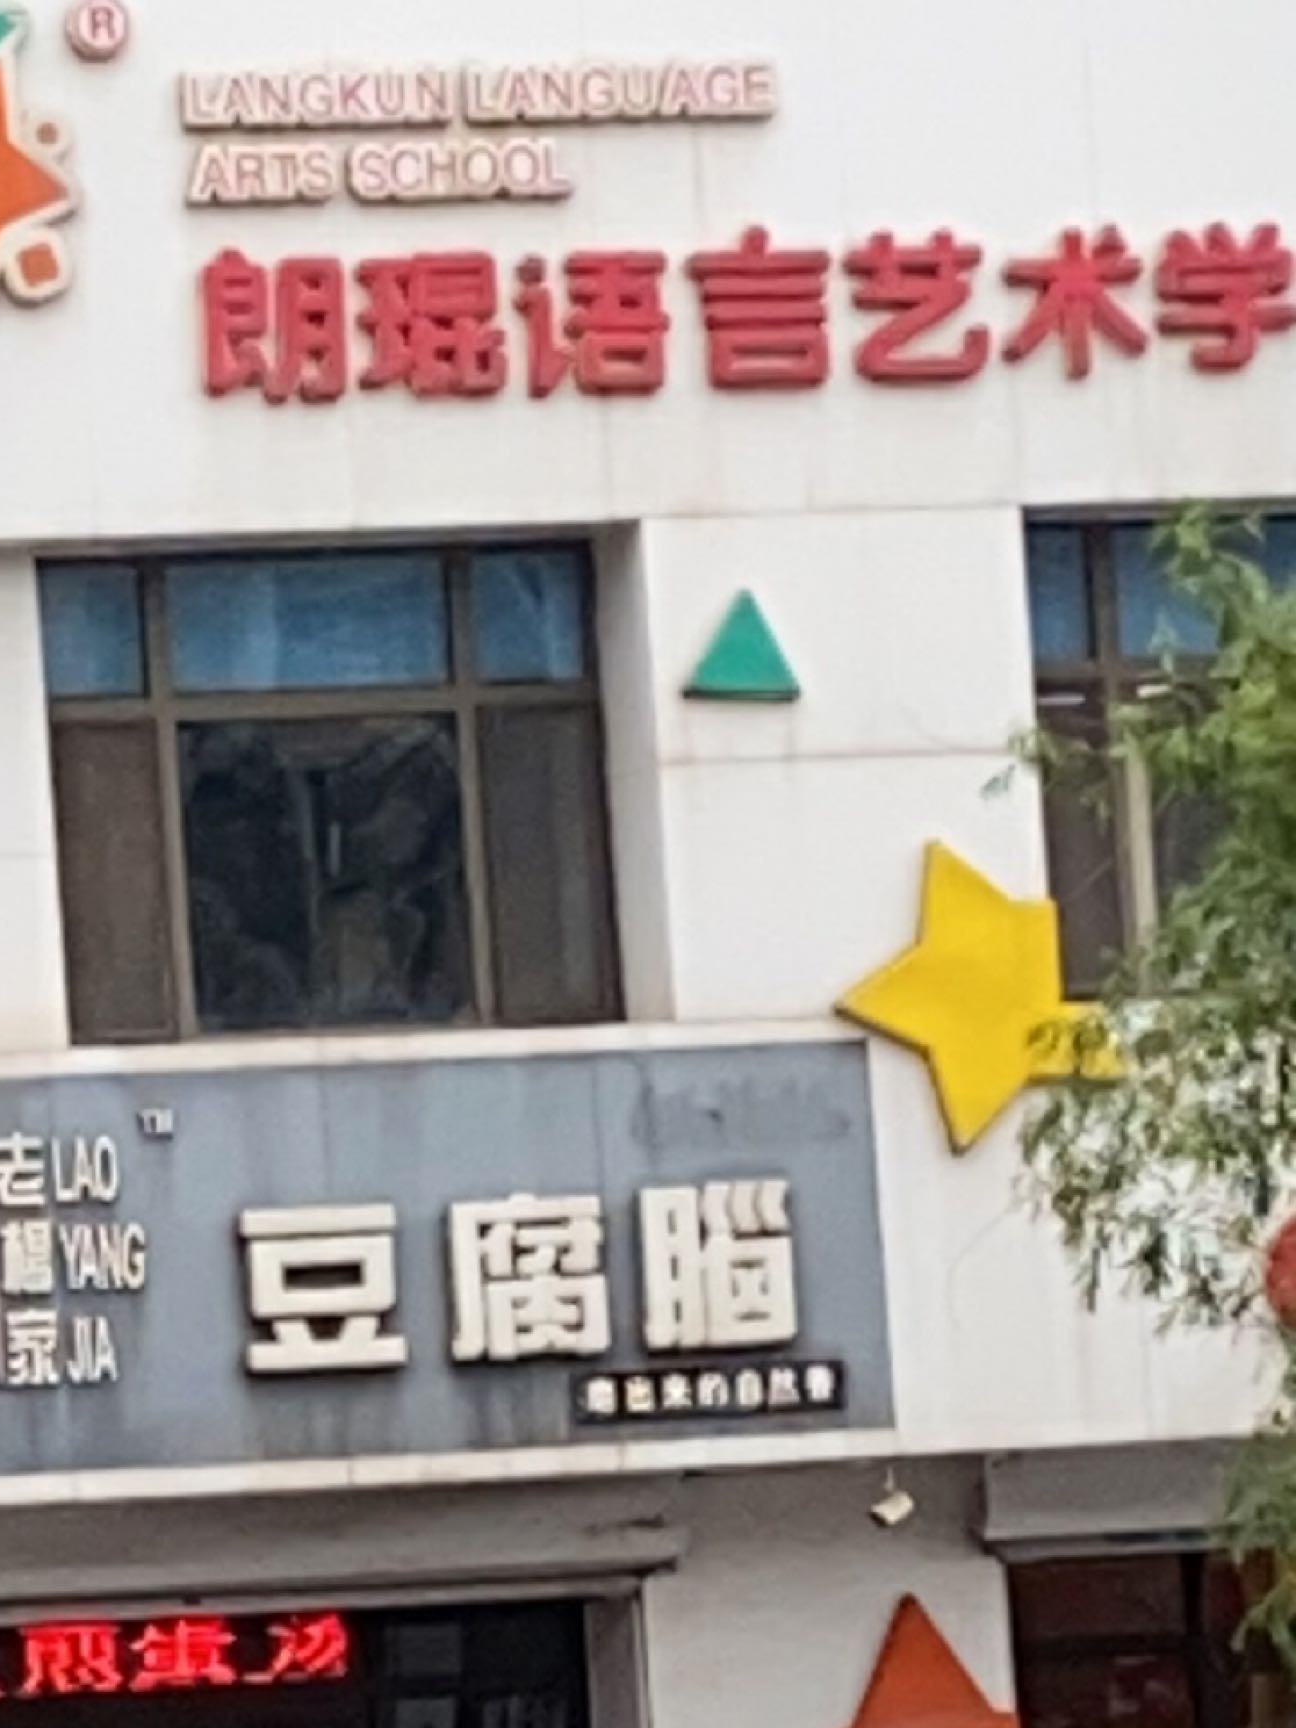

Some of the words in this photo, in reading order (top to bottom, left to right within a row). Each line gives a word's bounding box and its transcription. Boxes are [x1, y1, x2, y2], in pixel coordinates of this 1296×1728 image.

[179, 72, 455, 128] LANGKUN
[464, 63, 776, 122] LANGUAGE
[188, 142, 333, 204] ARTS
[347, 138, 572, 200] SCHOOL
[51, 1135, 120, 1202] LAO
[58, 1221, 147, 1291] YANG
[65, 1315, 119, 1384] JIA
